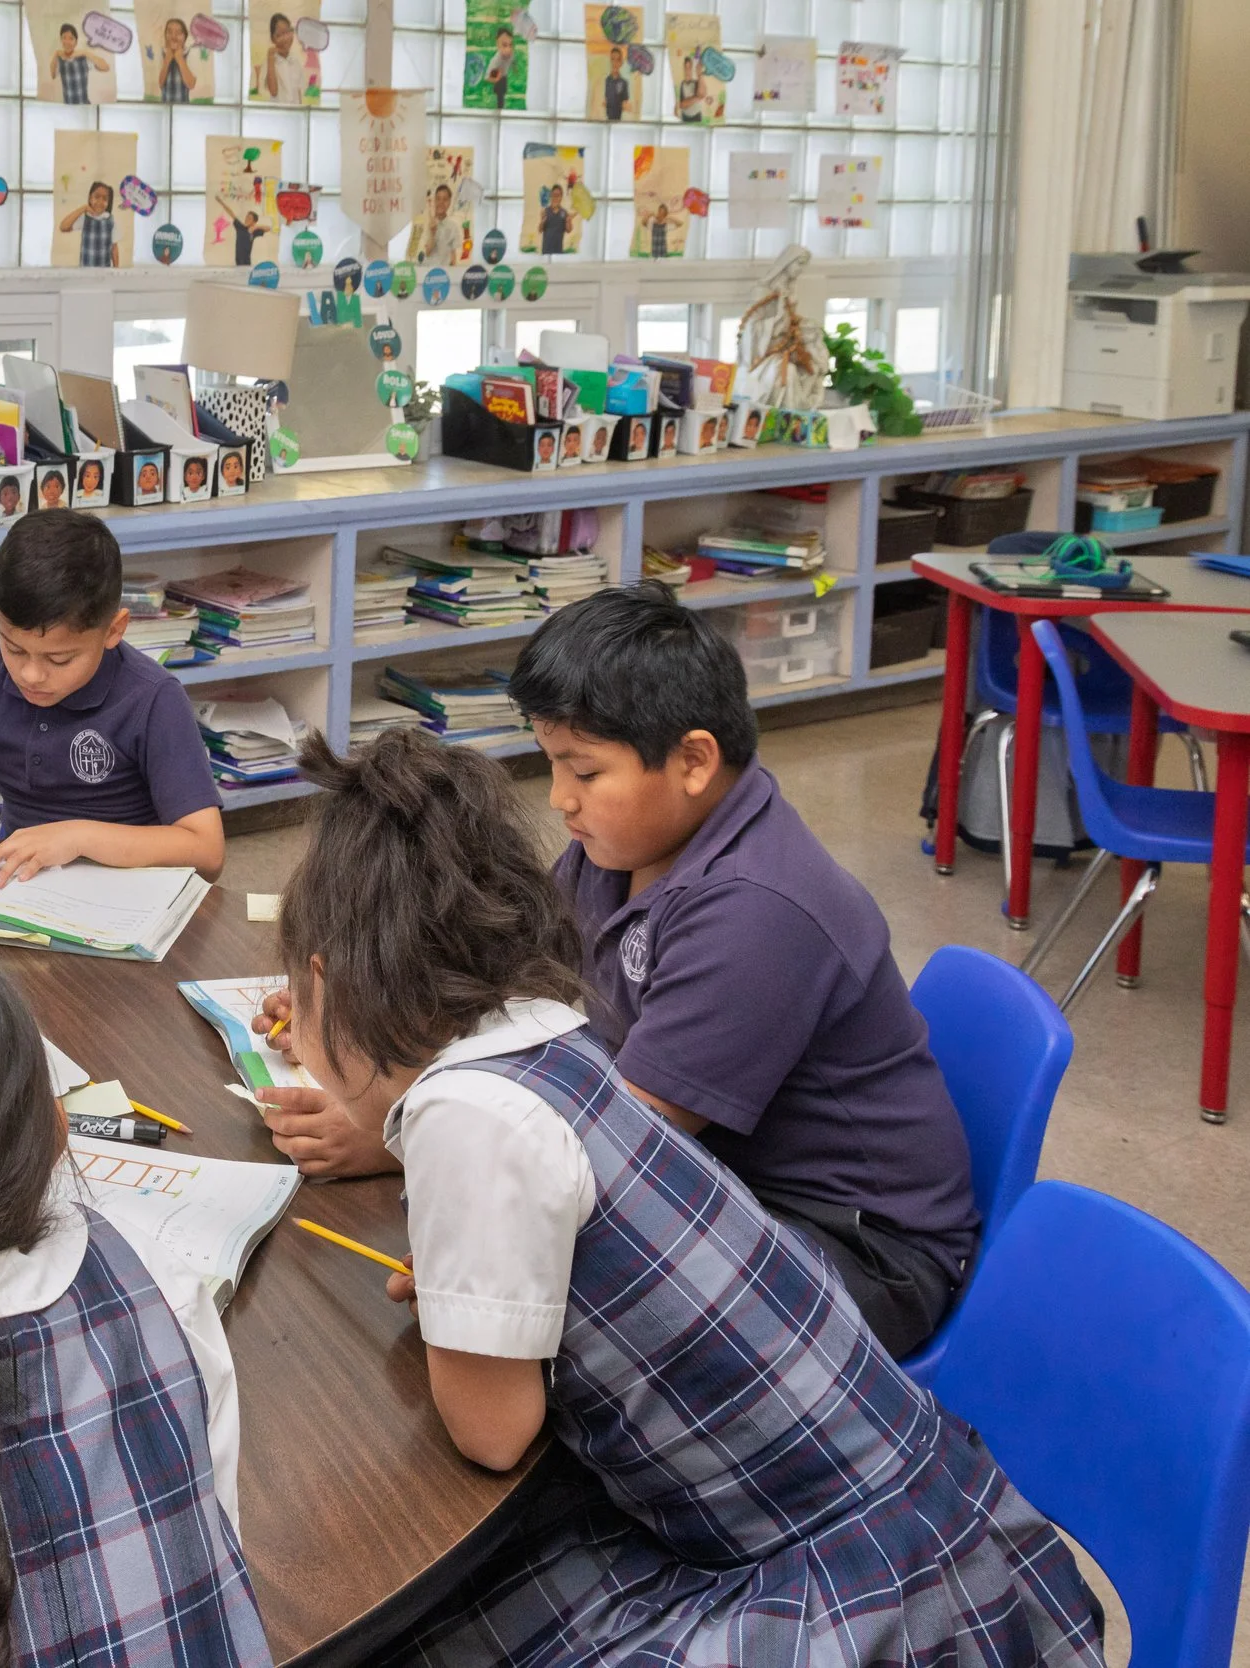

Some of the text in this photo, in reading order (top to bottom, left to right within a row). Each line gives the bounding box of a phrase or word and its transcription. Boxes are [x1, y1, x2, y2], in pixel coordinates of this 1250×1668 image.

[367, 177, 402, 194] PLANS
[79, 1119, 118, 1136] EXPO
[278, 1176, 289, 1186] 201
